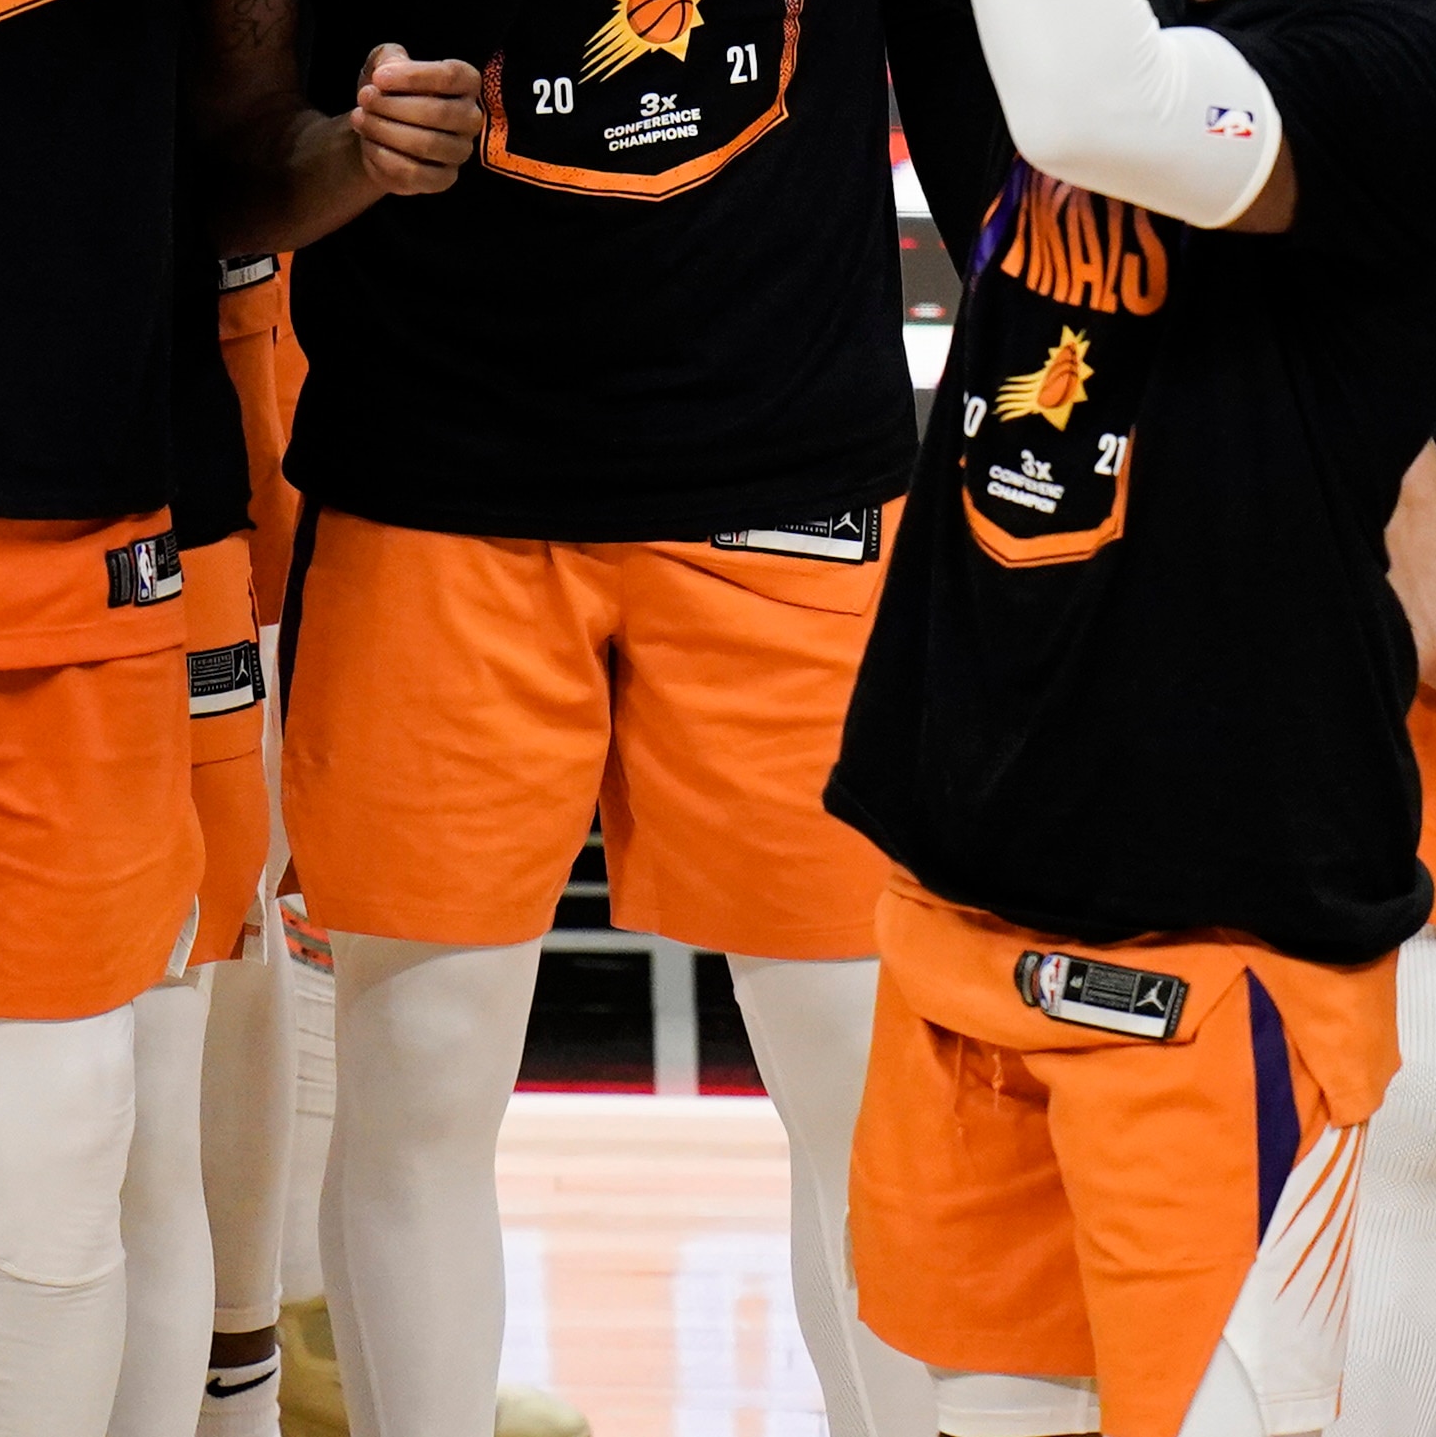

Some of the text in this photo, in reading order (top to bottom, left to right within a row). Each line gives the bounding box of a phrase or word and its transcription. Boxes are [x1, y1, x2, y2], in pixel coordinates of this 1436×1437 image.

[533, 43, 758, 115] 20 21
[604, 108, 702, 140] CONFERENCE
[608, 124, 699, 152] CHAMPIONS
[1094, 433, 1128, 477] 21
